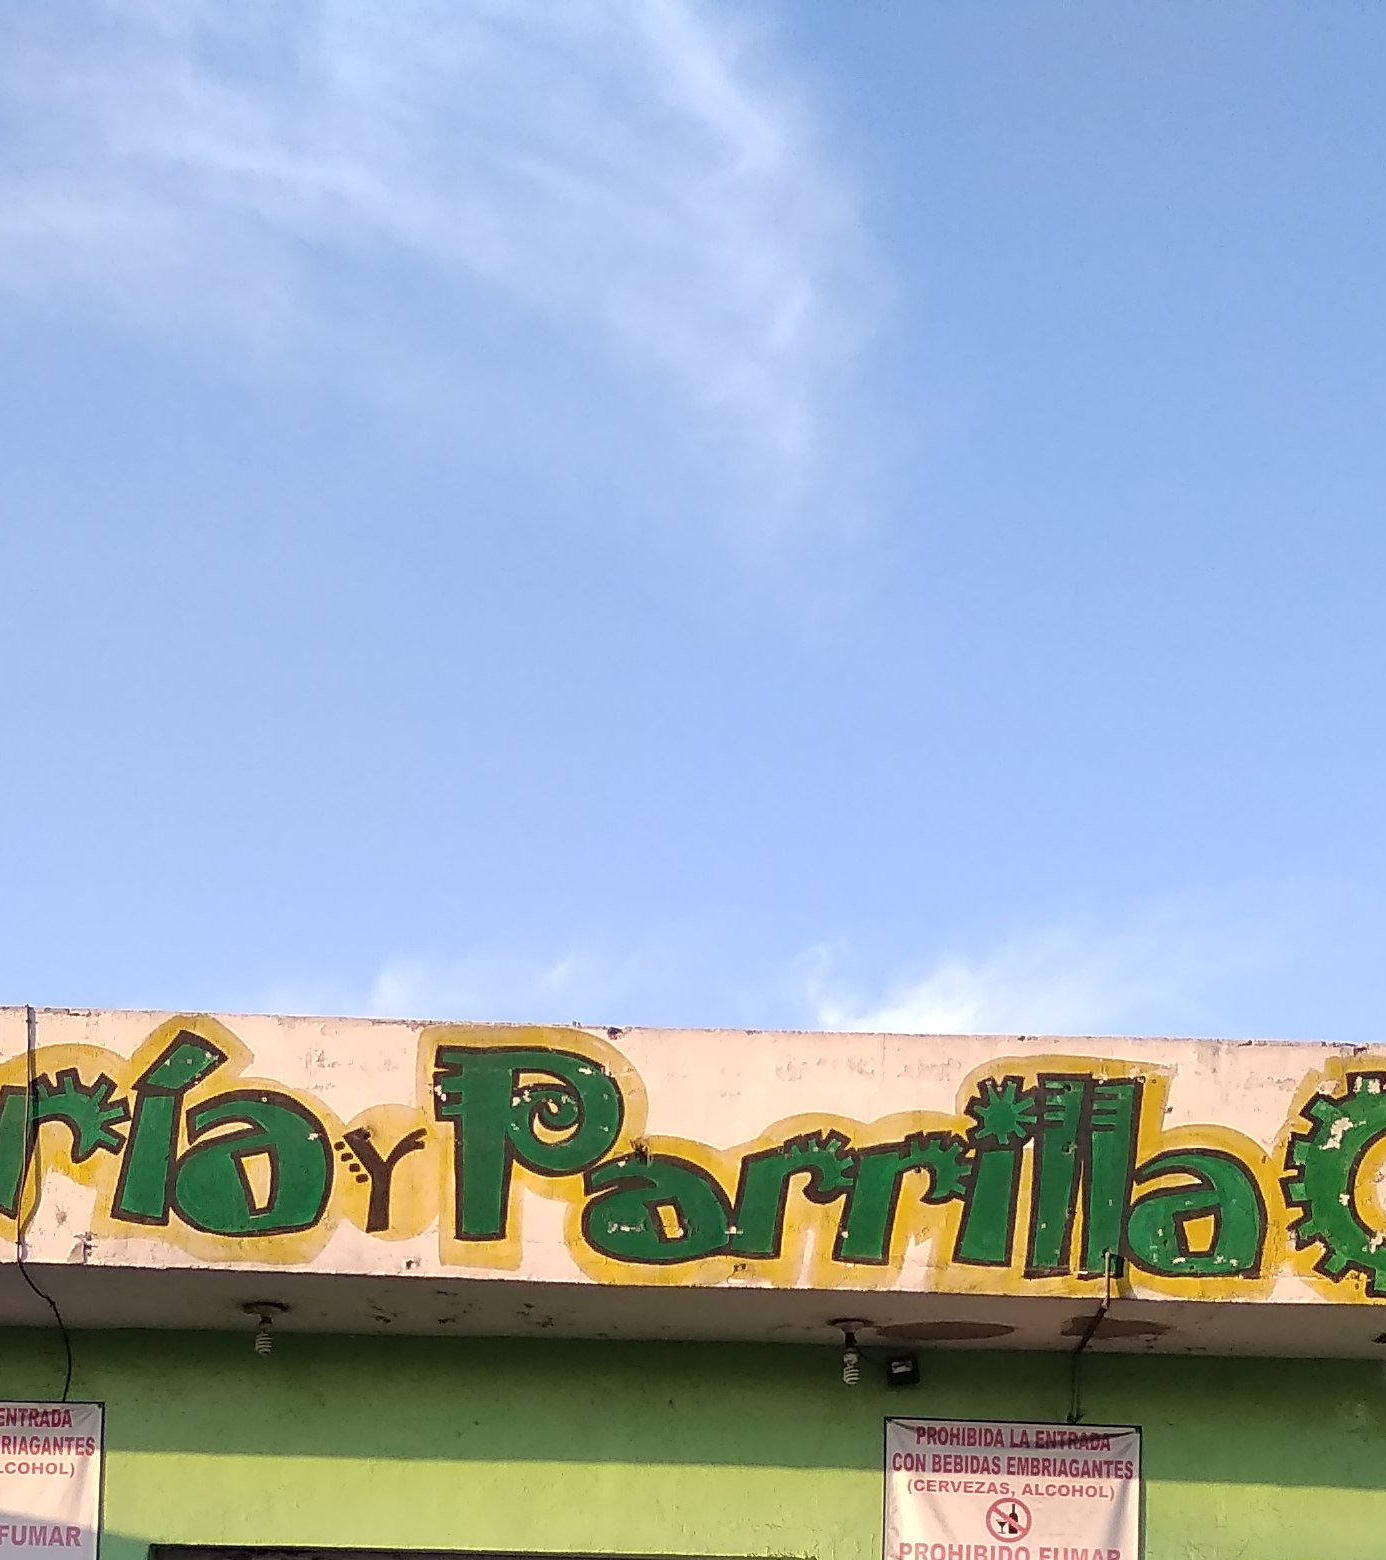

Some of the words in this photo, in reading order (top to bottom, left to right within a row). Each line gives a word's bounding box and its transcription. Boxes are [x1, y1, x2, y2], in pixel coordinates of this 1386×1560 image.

[433, 1044, 1266, 1280] Parrilla
[915, 1426, 1004, 1448] PROHIBIDA
[1009, 1429, 1030, 1449] LA
[1035, 1430, 1111, 1451] ENTRADA
[892, 1452, 927, 1473] CON
[932, 1454, 1001, 1475] BEBIDAS
[1006, 1456, 1133, 1480] EMBRIAGANTES
[907, 1479, 1016, 1497] (CERVEZAS,
[1021, 1483, 1115, 1501] ALCOHOL)
